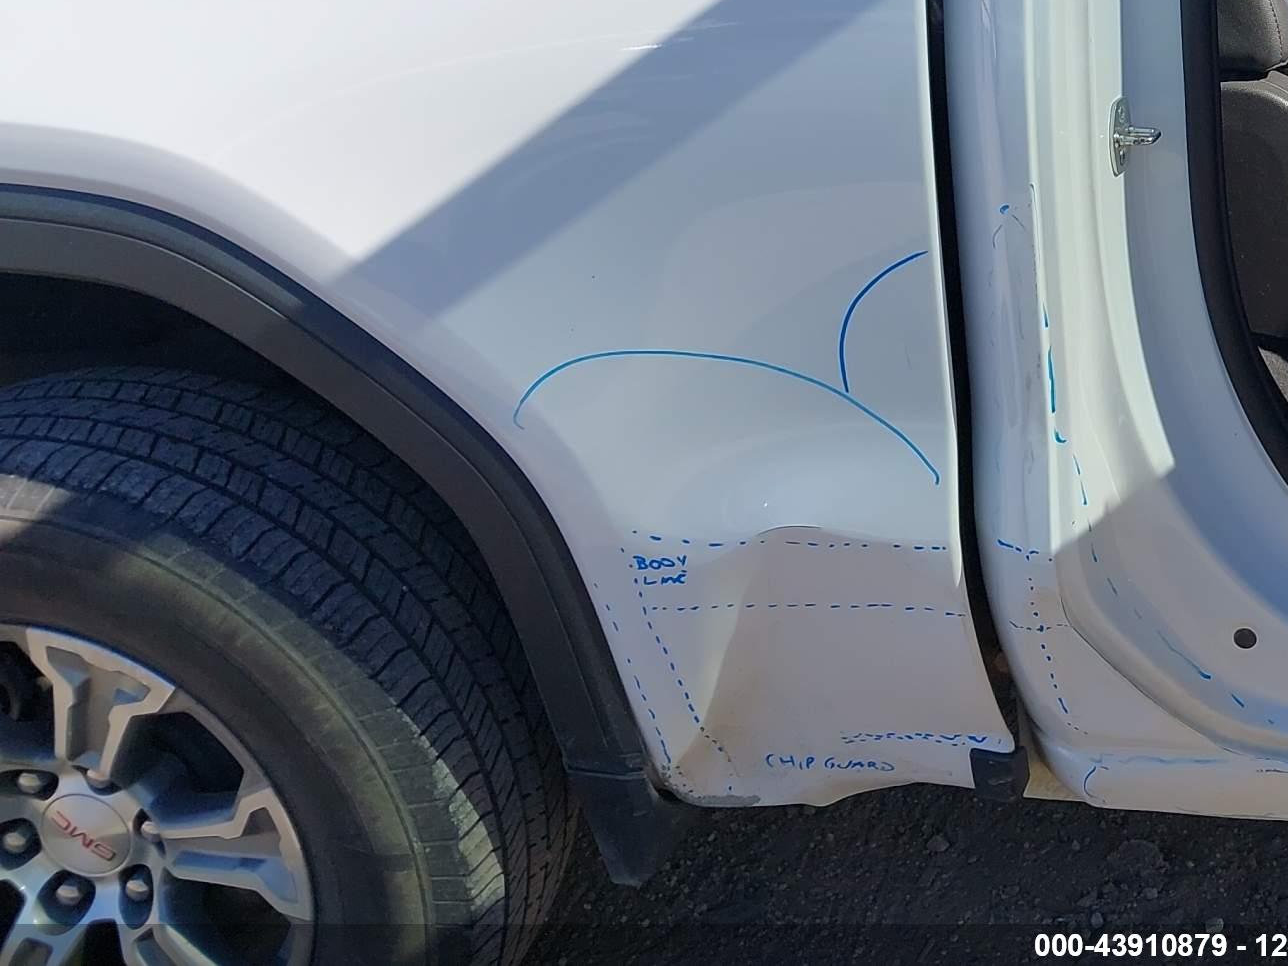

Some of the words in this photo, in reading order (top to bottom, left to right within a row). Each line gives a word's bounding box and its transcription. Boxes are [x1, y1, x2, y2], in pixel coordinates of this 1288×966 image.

[632, 554, 688, 571] BODY
[765, 753, 817, 770] CHIP
[824, 756, 896, 773] GUARD
[52, 809, 117, 862] GMC
